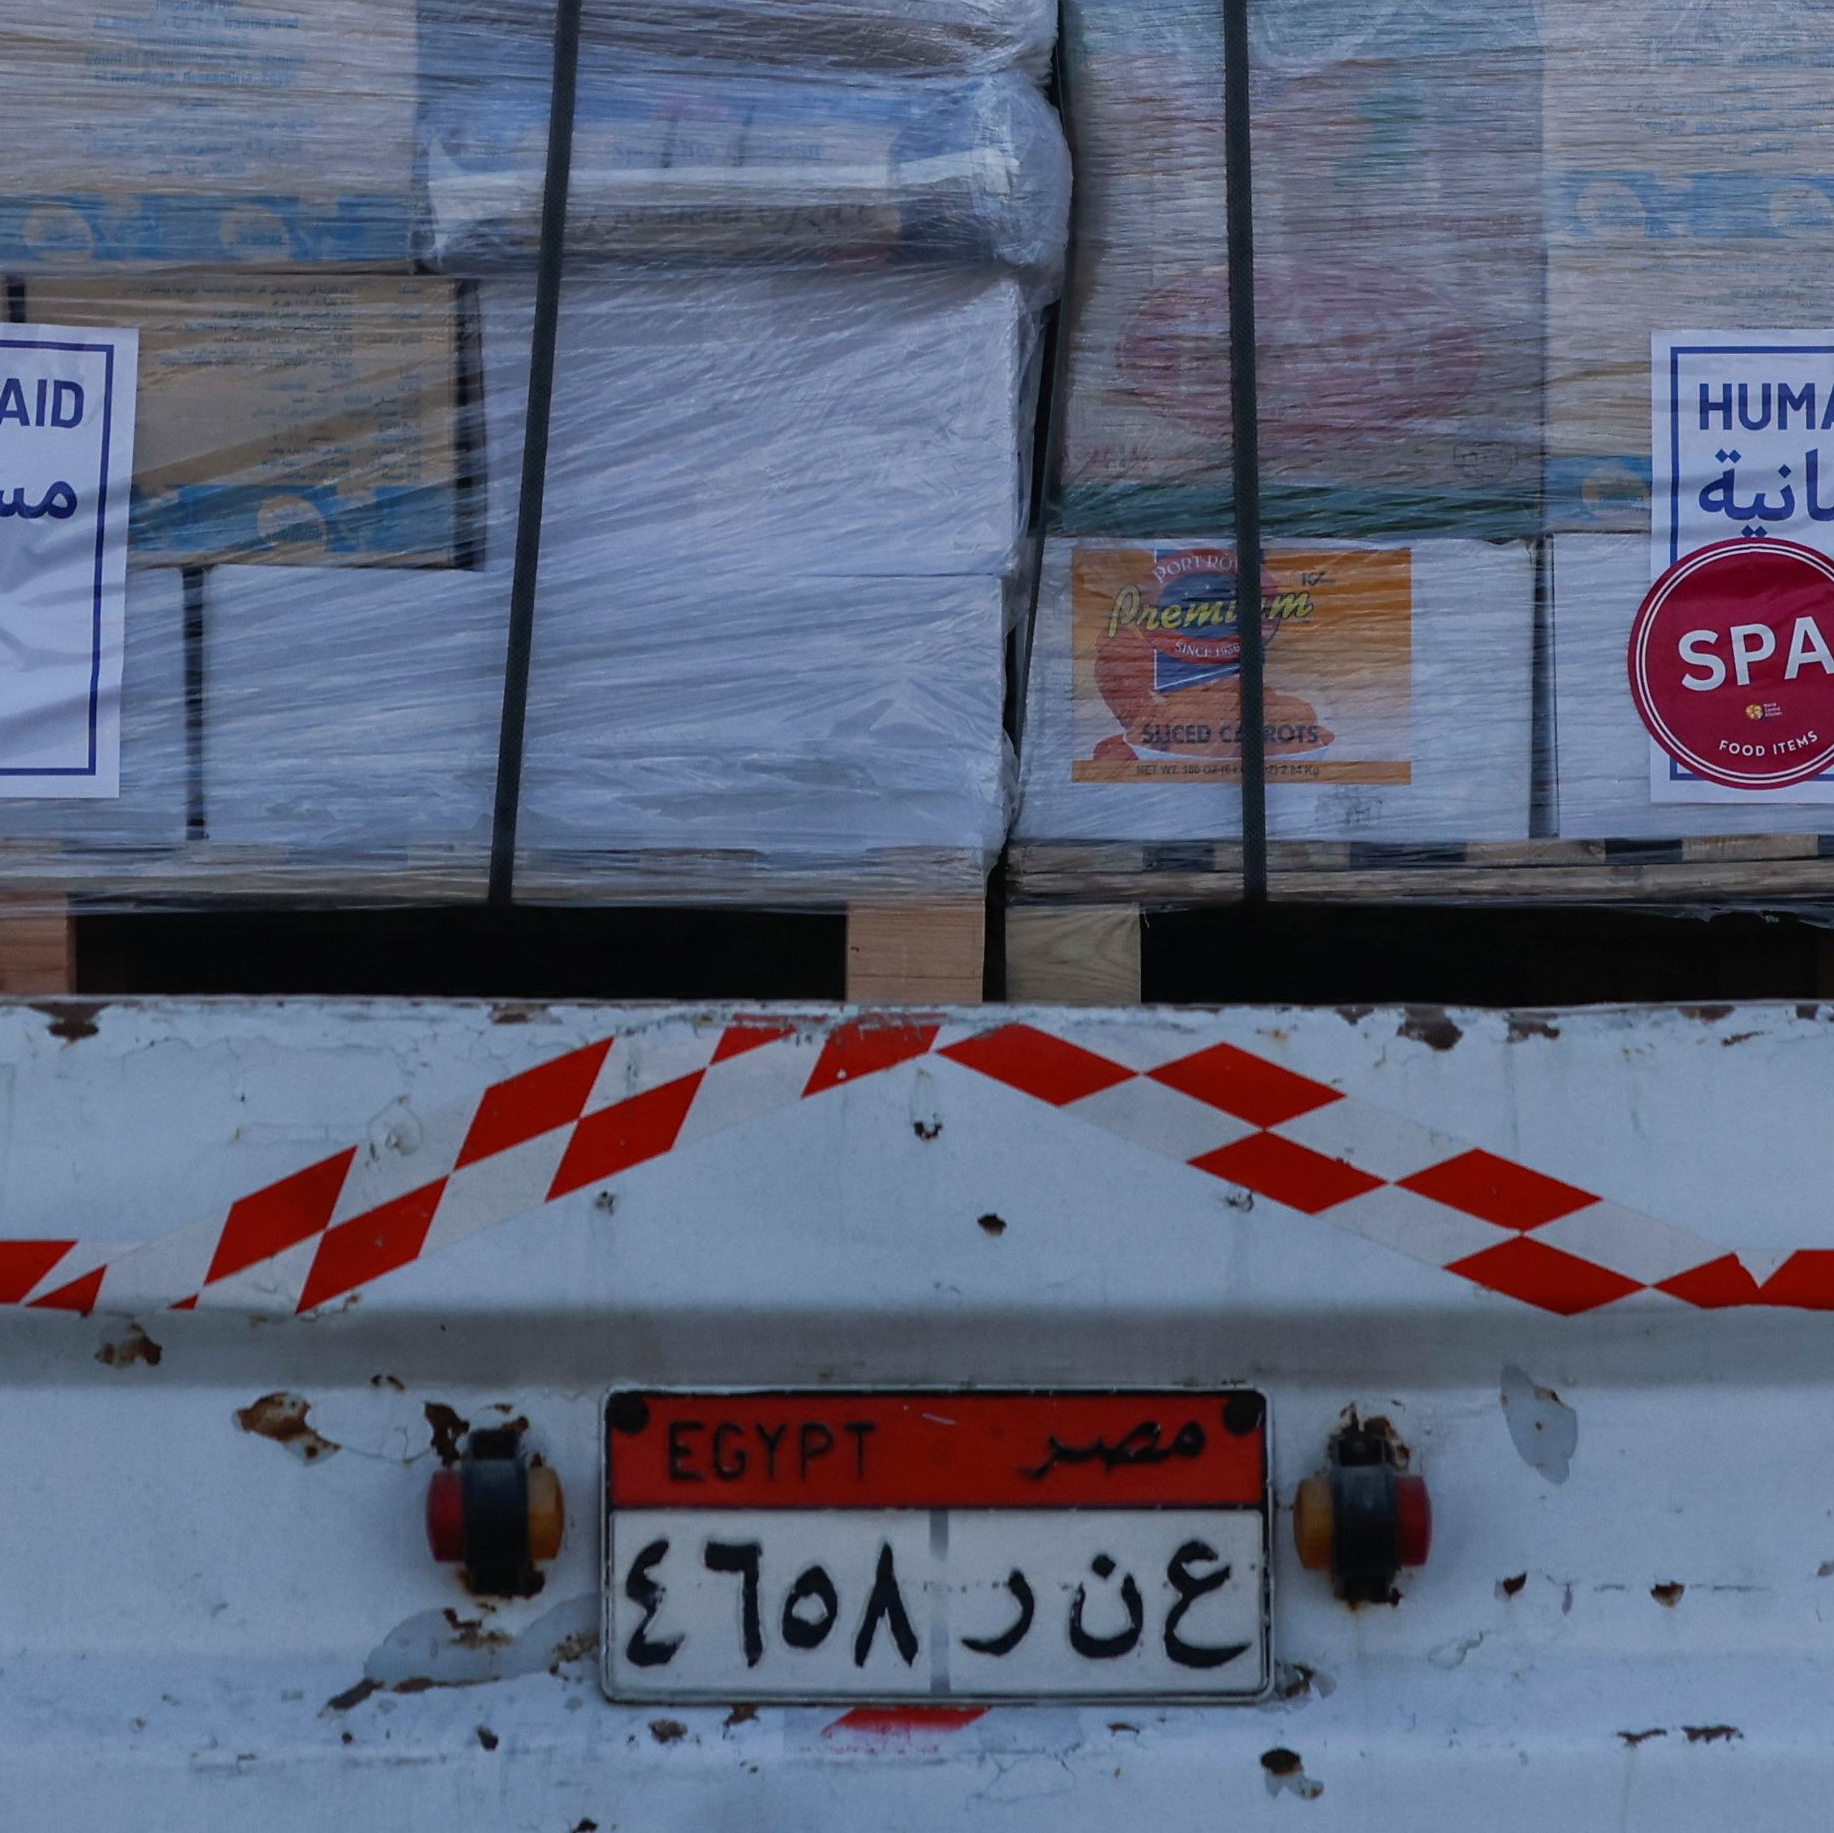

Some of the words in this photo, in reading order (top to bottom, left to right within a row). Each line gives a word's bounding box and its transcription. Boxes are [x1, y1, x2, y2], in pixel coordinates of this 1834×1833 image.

[1153, 554, 1203, 583] PORT
[1107, 583, 1315, 639] Premim
[1142, 724, 1212, 744] SLICED
[1719, 739, 1766, 757] FOOD
[1773, 730, 1819, 756] ITEMS
[667, 1419, 877, 1483] EGYPT
[1021, 1419, 1207, 1481] مصر
